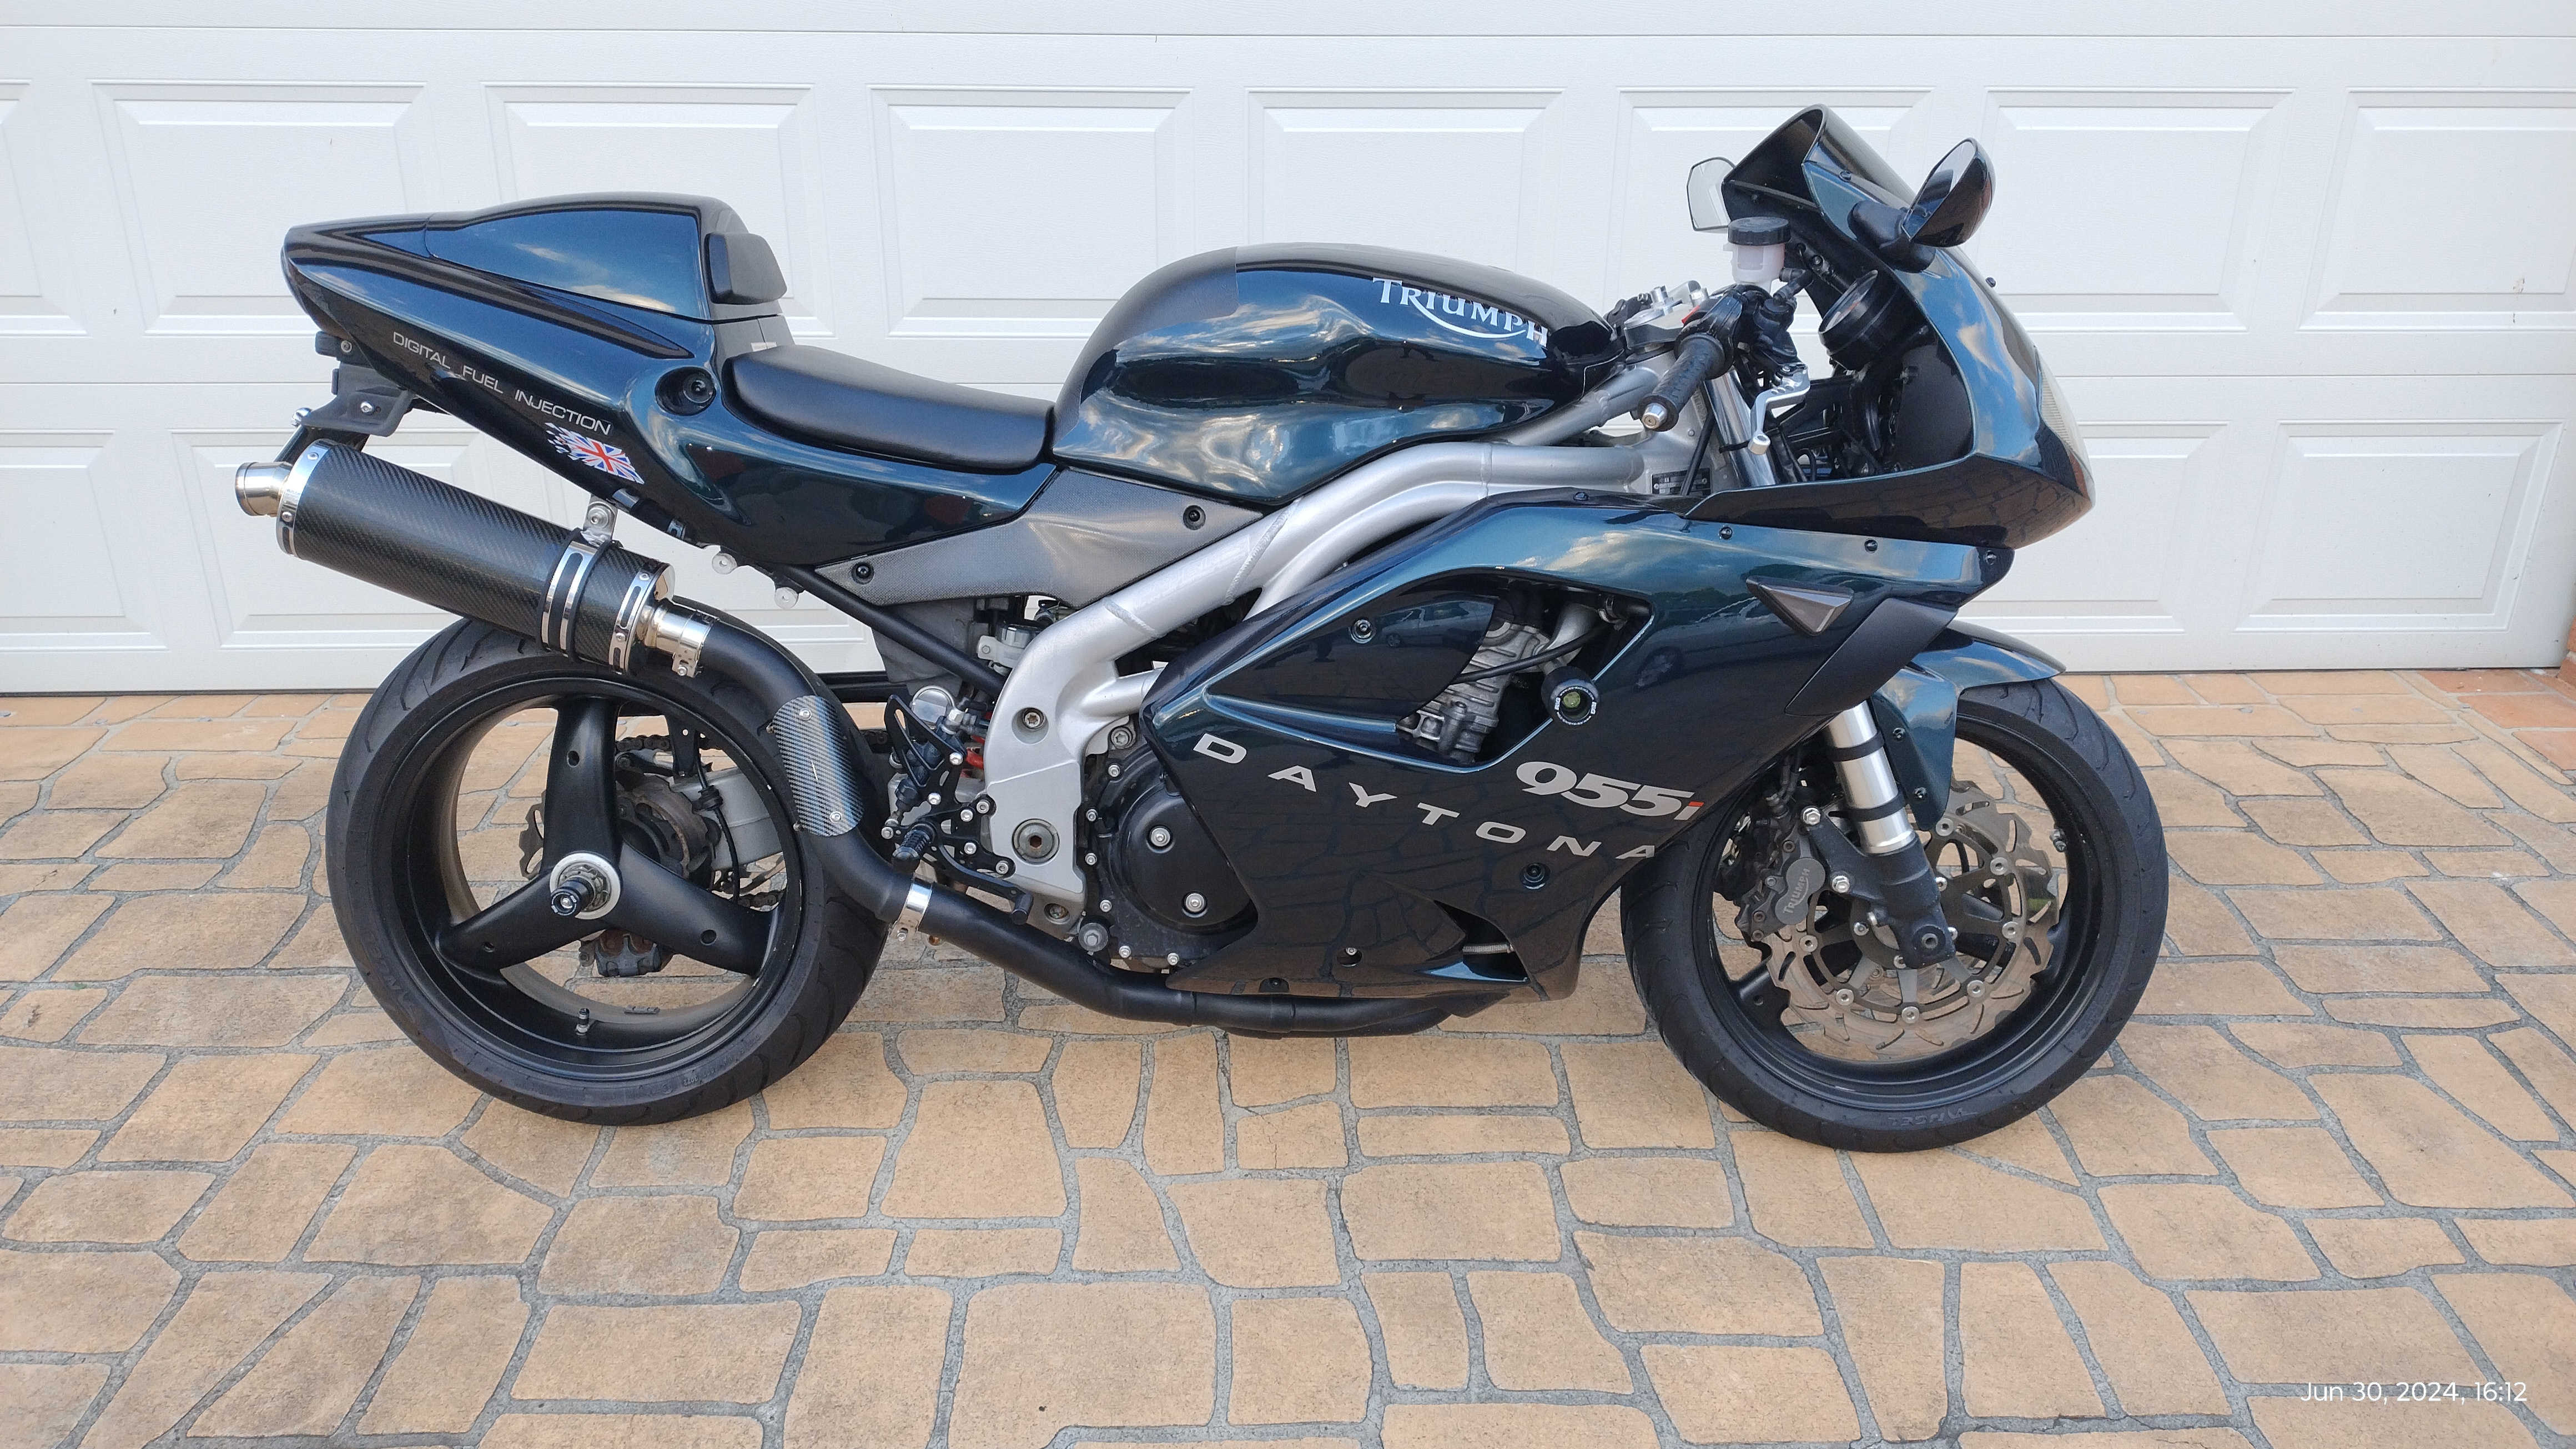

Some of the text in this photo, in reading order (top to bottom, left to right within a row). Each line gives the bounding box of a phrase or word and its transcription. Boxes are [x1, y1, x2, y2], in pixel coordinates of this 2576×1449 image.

[1372, 276, 1549, 348] TRIUMPH
[393, 331, 611, 436] DIGITAL FUEL INJECTION
[1193, 733, 1656, 861] DAYTONA
[1516, 761, 1704, 821] 955i
[1783, 868, 1810, 914] TRIUMPH
